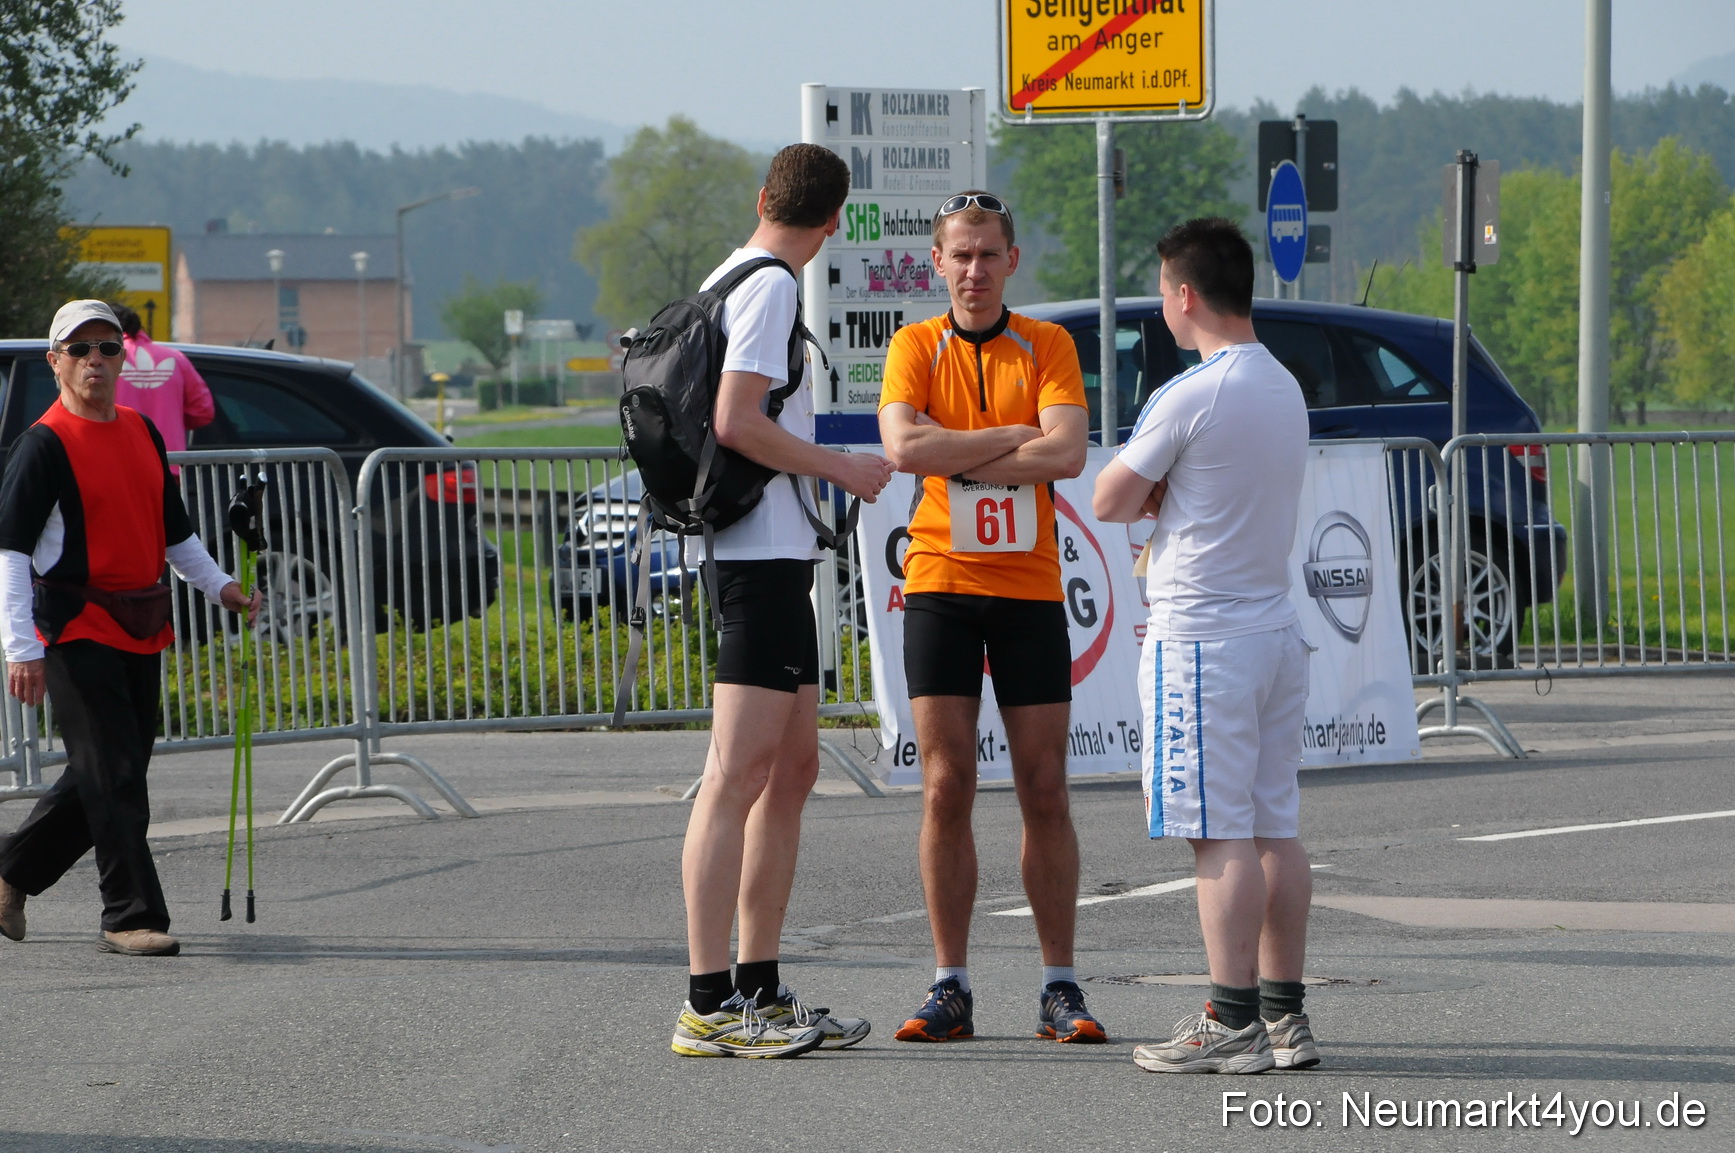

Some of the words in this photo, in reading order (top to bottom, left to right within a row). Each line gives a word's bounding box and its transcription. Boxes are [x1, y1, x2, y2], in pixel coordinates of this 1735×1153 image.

[1047, 34, 1081, 51] am
[1094, 28, 1164, 55] Anger
[1022, 73, 1058, 92] Kreis
[1065, 71, 1135, 91] Neumarkt
[882, 93, 950, 116] HOLZAMMER
[882, 120, 950, 137] Kunststofftechnik
[882, 146, 951, 169] HOLZAMMER
[846, 203, 881, 244] SHB
[861, 258, 892, 280] Trend
[622, 405, 636, 441] CAMELBAK
[962, 483, 1005, 492] WERBUNG
[976, 497, 1017, 546] 61
[1168, 693, 1187, 793] ITALIA
